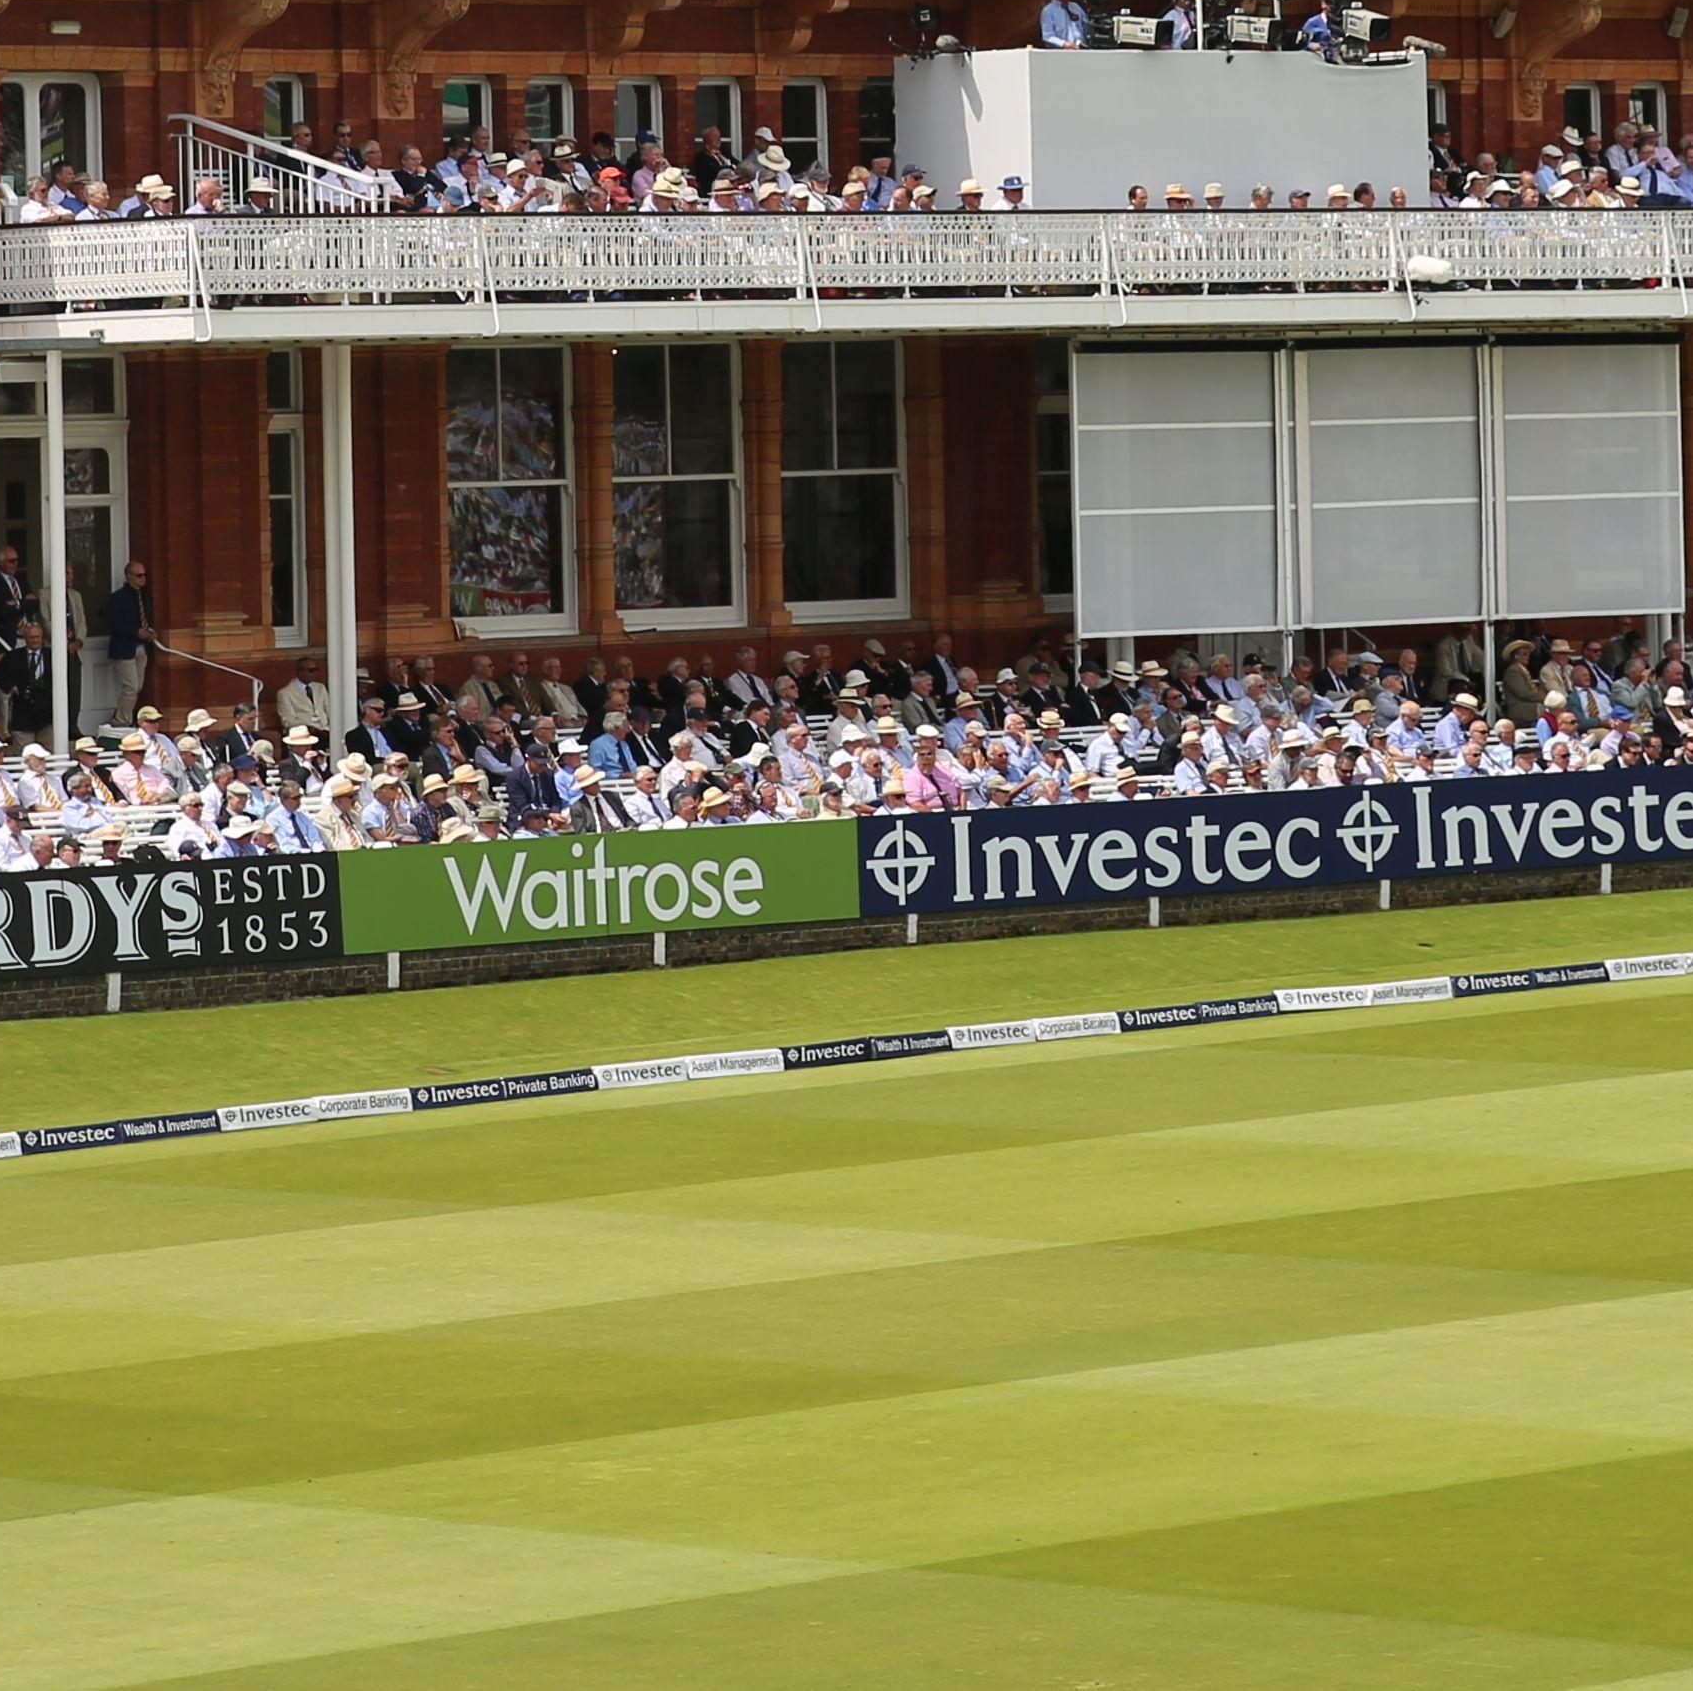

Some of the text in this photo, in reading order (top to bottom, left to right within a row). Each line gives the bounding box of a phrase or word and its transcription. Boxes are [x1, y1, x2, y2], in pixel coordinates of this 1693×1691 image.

[949, 814, 1321, 903] Investec
[212, 862, 327, 906] ESTD
[441, 836, 765, 936] Waitrose
[217, 910, 329, 955] 1853
[1470, 973, 1530, 991] Investec
[1624, 958, 1679, 975] Investec
[1296, 982, 1449, 1005] Investec Asset Management
[1135, 997, 1278, 1027] Investec Private Banking
[967, 1016, 1117, 1043] Investec Corporate Banking
[800, 1034, 949, 1063] Investec Wealth & Investment
[615, 1053, 780, 1083] Investec Asset Management
[431, 1071, 596, 1104] Investec Private Banking
[240, 1092, 409, 1124] Investec Corporate Banking
[40, 1115, 217, 1148] Investec Wealth & Investment
